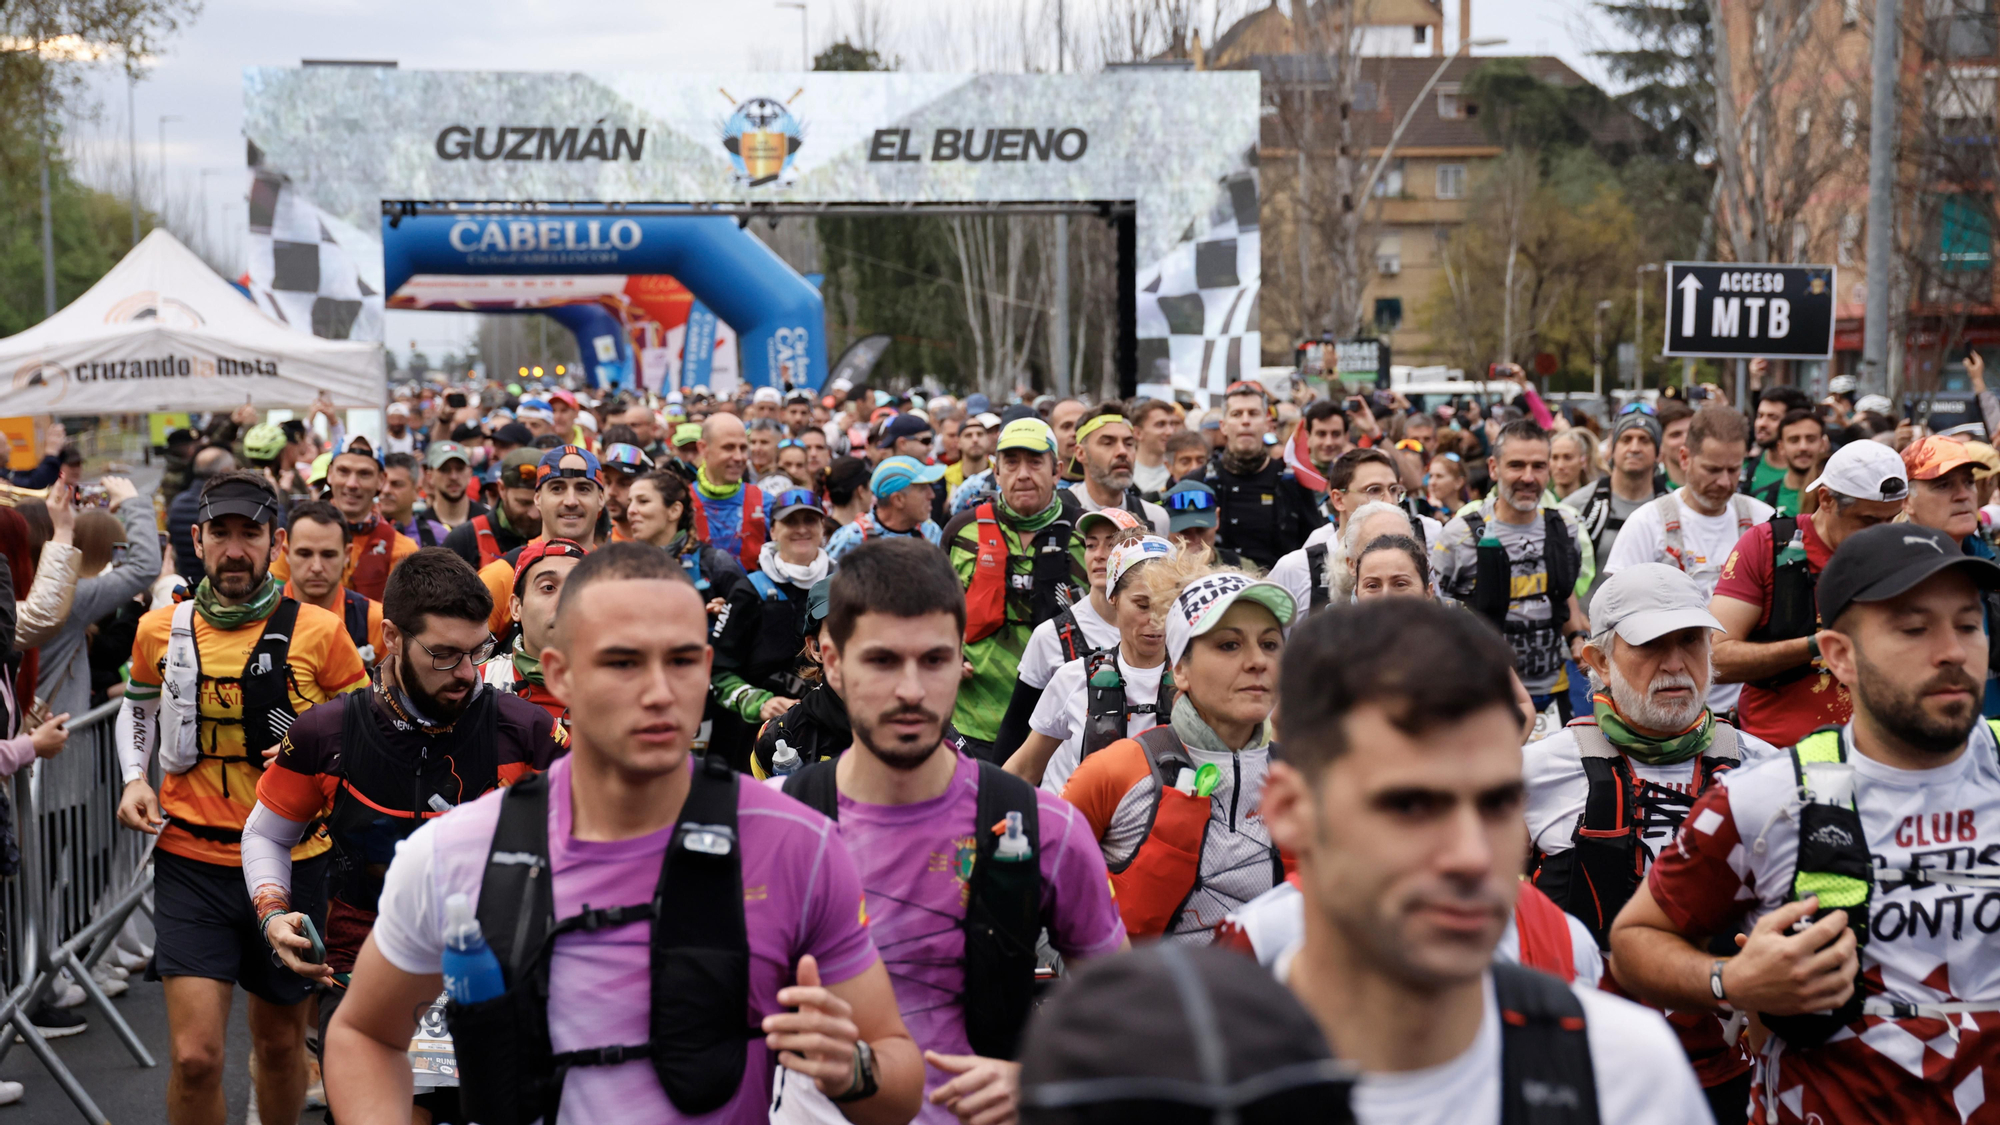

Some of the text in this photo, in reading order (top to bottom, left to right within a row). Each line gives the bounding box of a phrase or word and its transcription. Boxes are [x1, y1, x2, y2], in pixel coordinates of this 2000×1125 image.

[436, 118, 646, 161] GUZMÁN
[868, 127, 1088, 162] EL BUENO
[449, 218, 643, 252] CABELLO
[1718, 271, 1785, 293] ACCESO
[1711, 296, 1790, 339] MTB
[1895, 808, 1977, 848] CLUB
